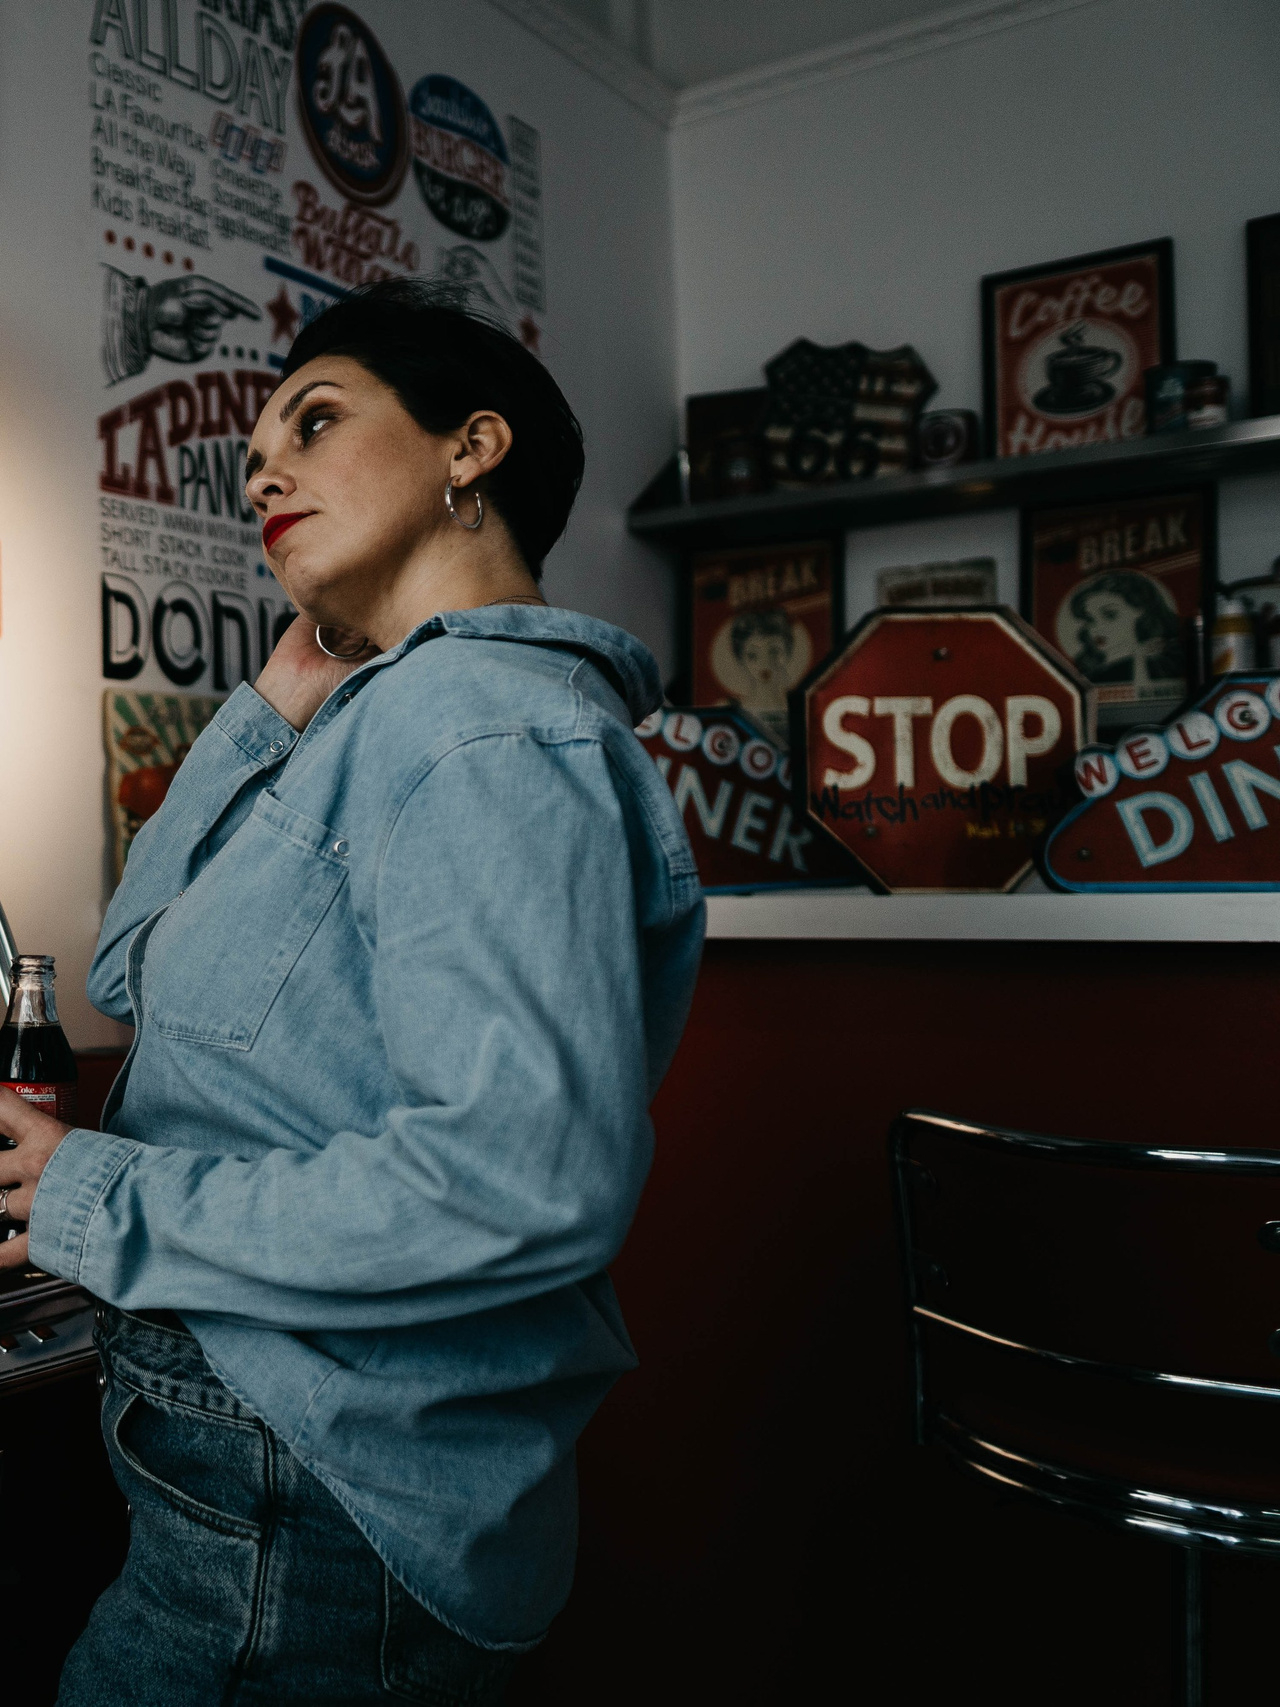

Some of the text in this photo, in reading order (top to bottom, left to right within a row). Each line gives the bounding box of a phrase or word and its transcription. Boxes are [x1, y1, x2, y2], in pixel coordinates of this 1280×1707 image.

[196, 10, 291, 137] DAY
[1009, 274, 1149, 339] Coffee
[99, 386, 174, 504] LA
[100, 497, 158, 527] SERVED
[1078, 509, 1189, 573] BREAK
[101, 546, 140, 573] TALL
[821, 694, 1063, 793] STOP
[811, 783, 919, 824] Watch
[921, 783, 977, 811] and
[15, 1085, 36, 1094] Coke
